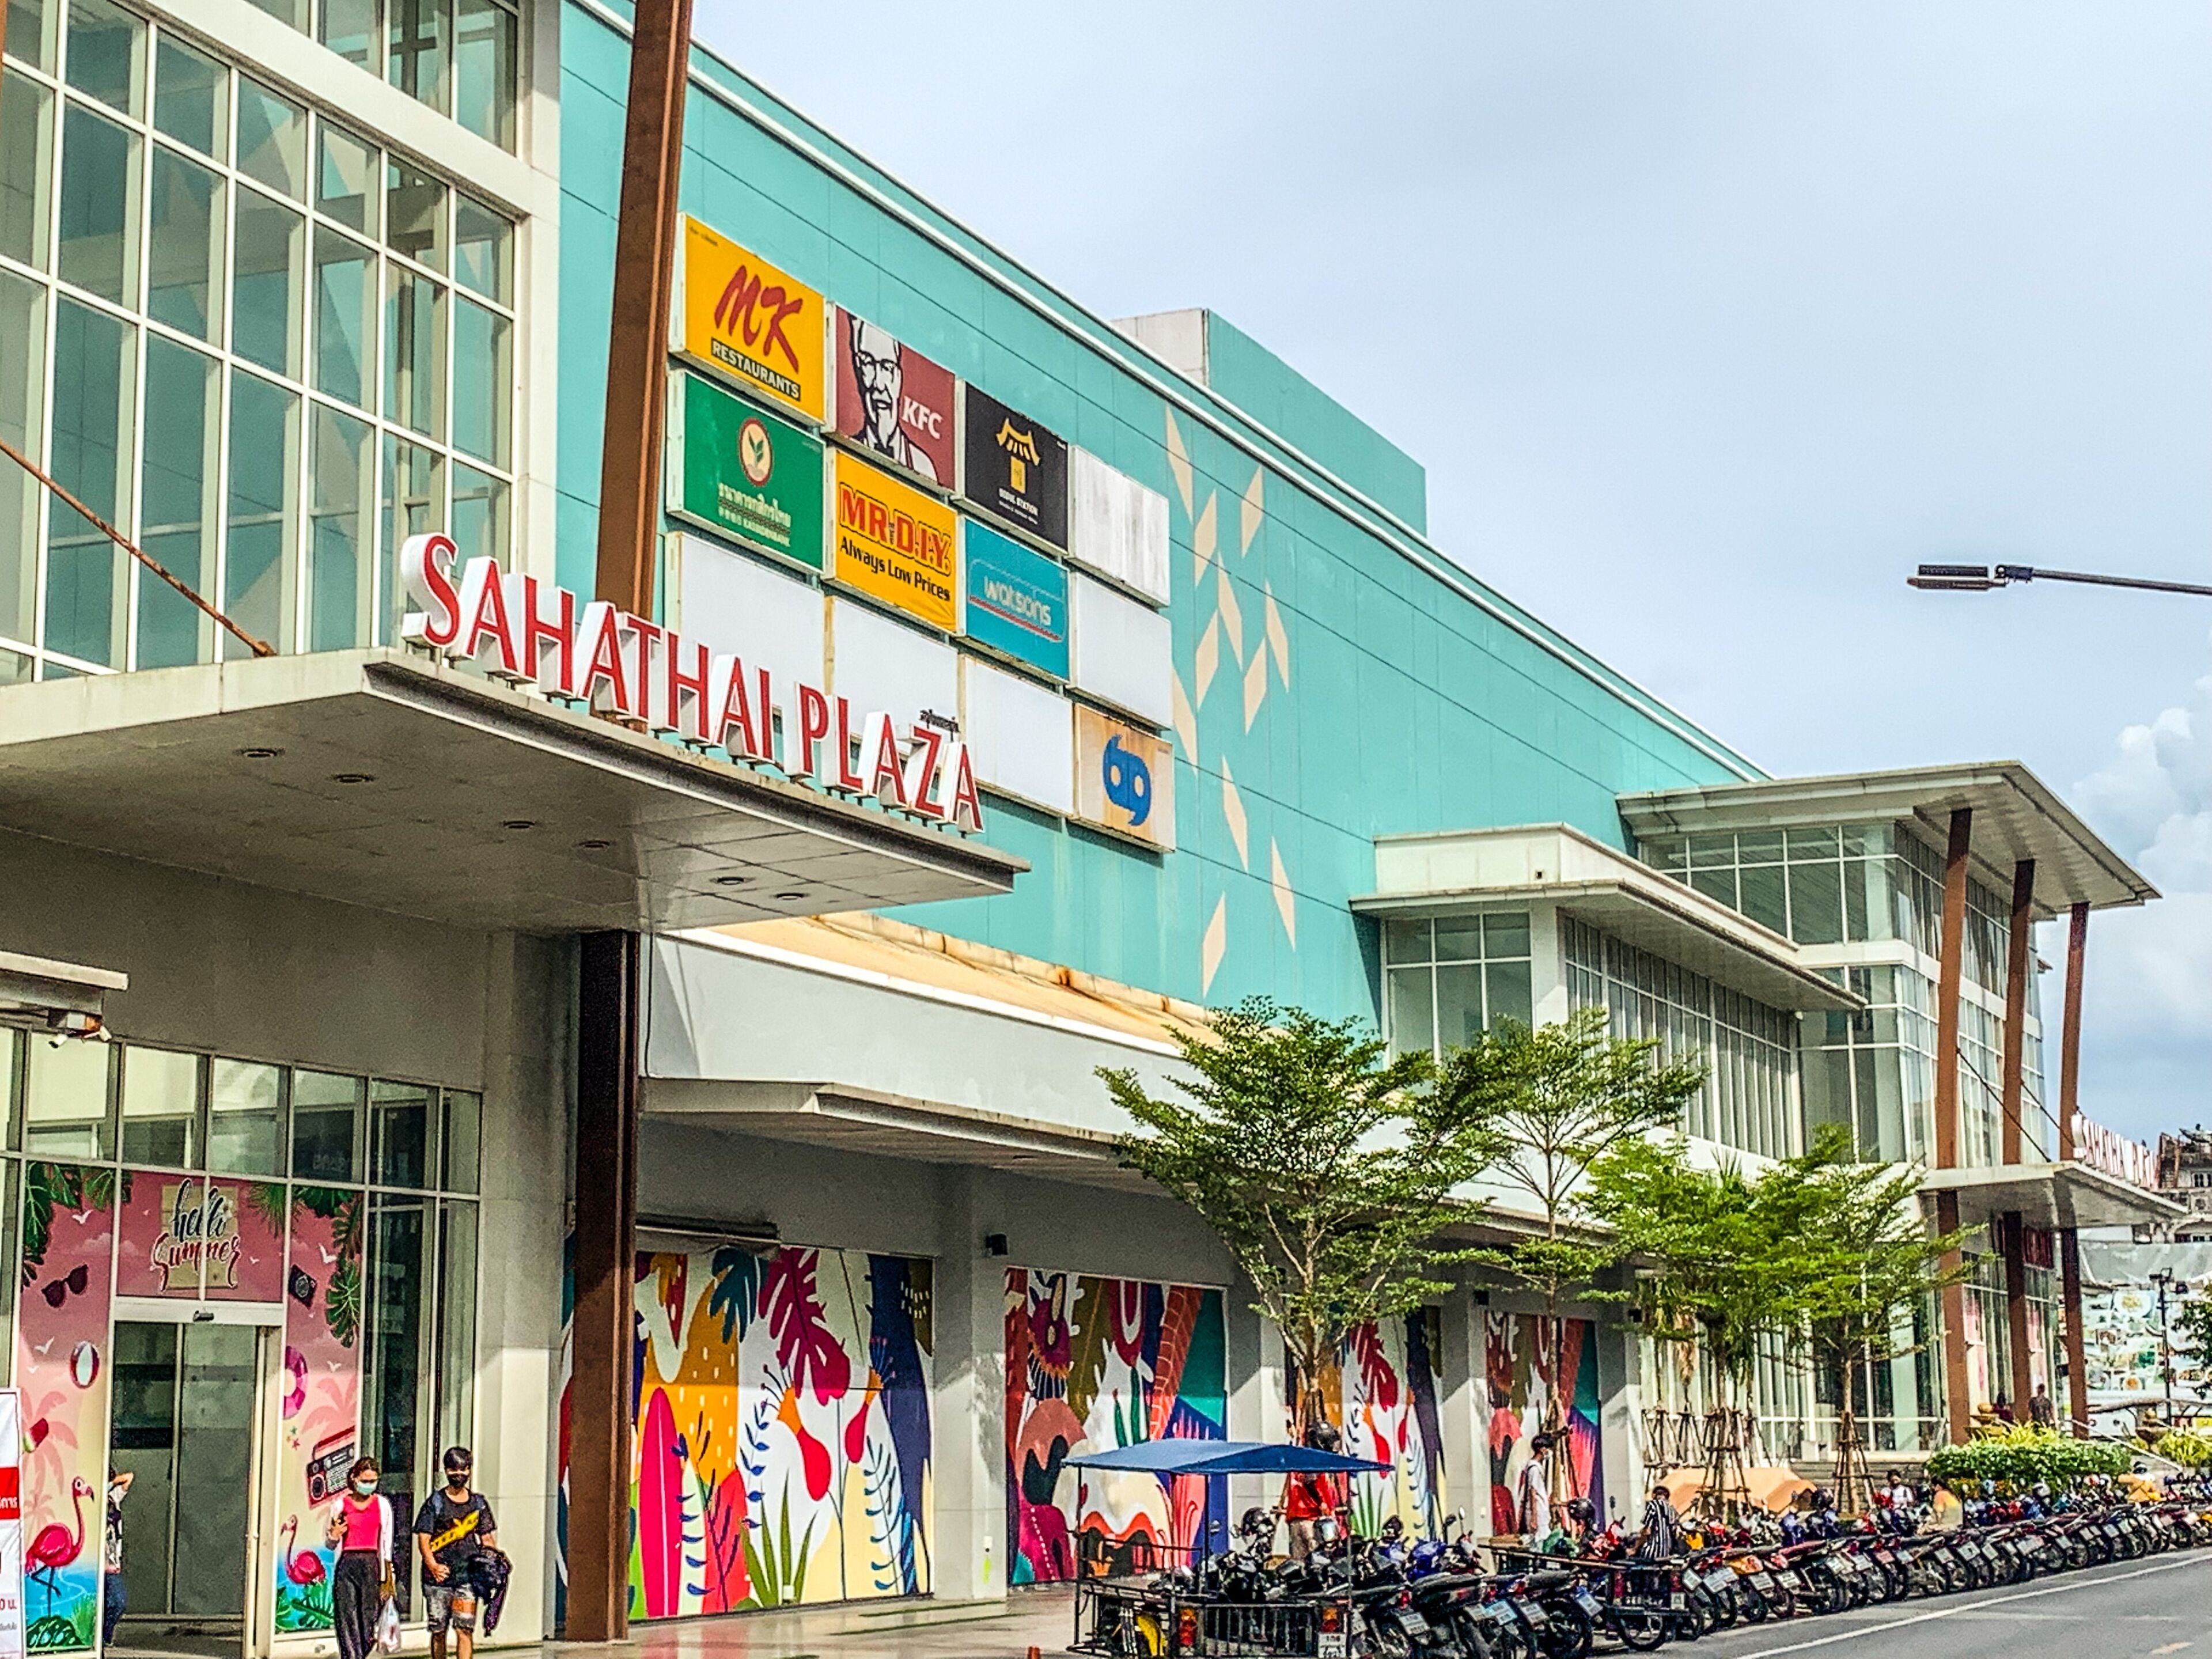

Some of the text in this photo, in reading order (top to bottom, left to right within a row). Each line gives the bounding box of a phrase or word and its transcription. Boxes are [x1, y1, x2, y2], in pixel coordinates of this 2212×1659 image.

[713, 264, 803, 374] MK
[711, 339, 800, 400] RESTAURANTS
[901, 396, 943, 440] KFC
[840, 536, 950, 601] Always Low Prices
[983, 575, 1052, 626] watsons
[404, 533, 984, 834] SAHATHAI PLAZA
